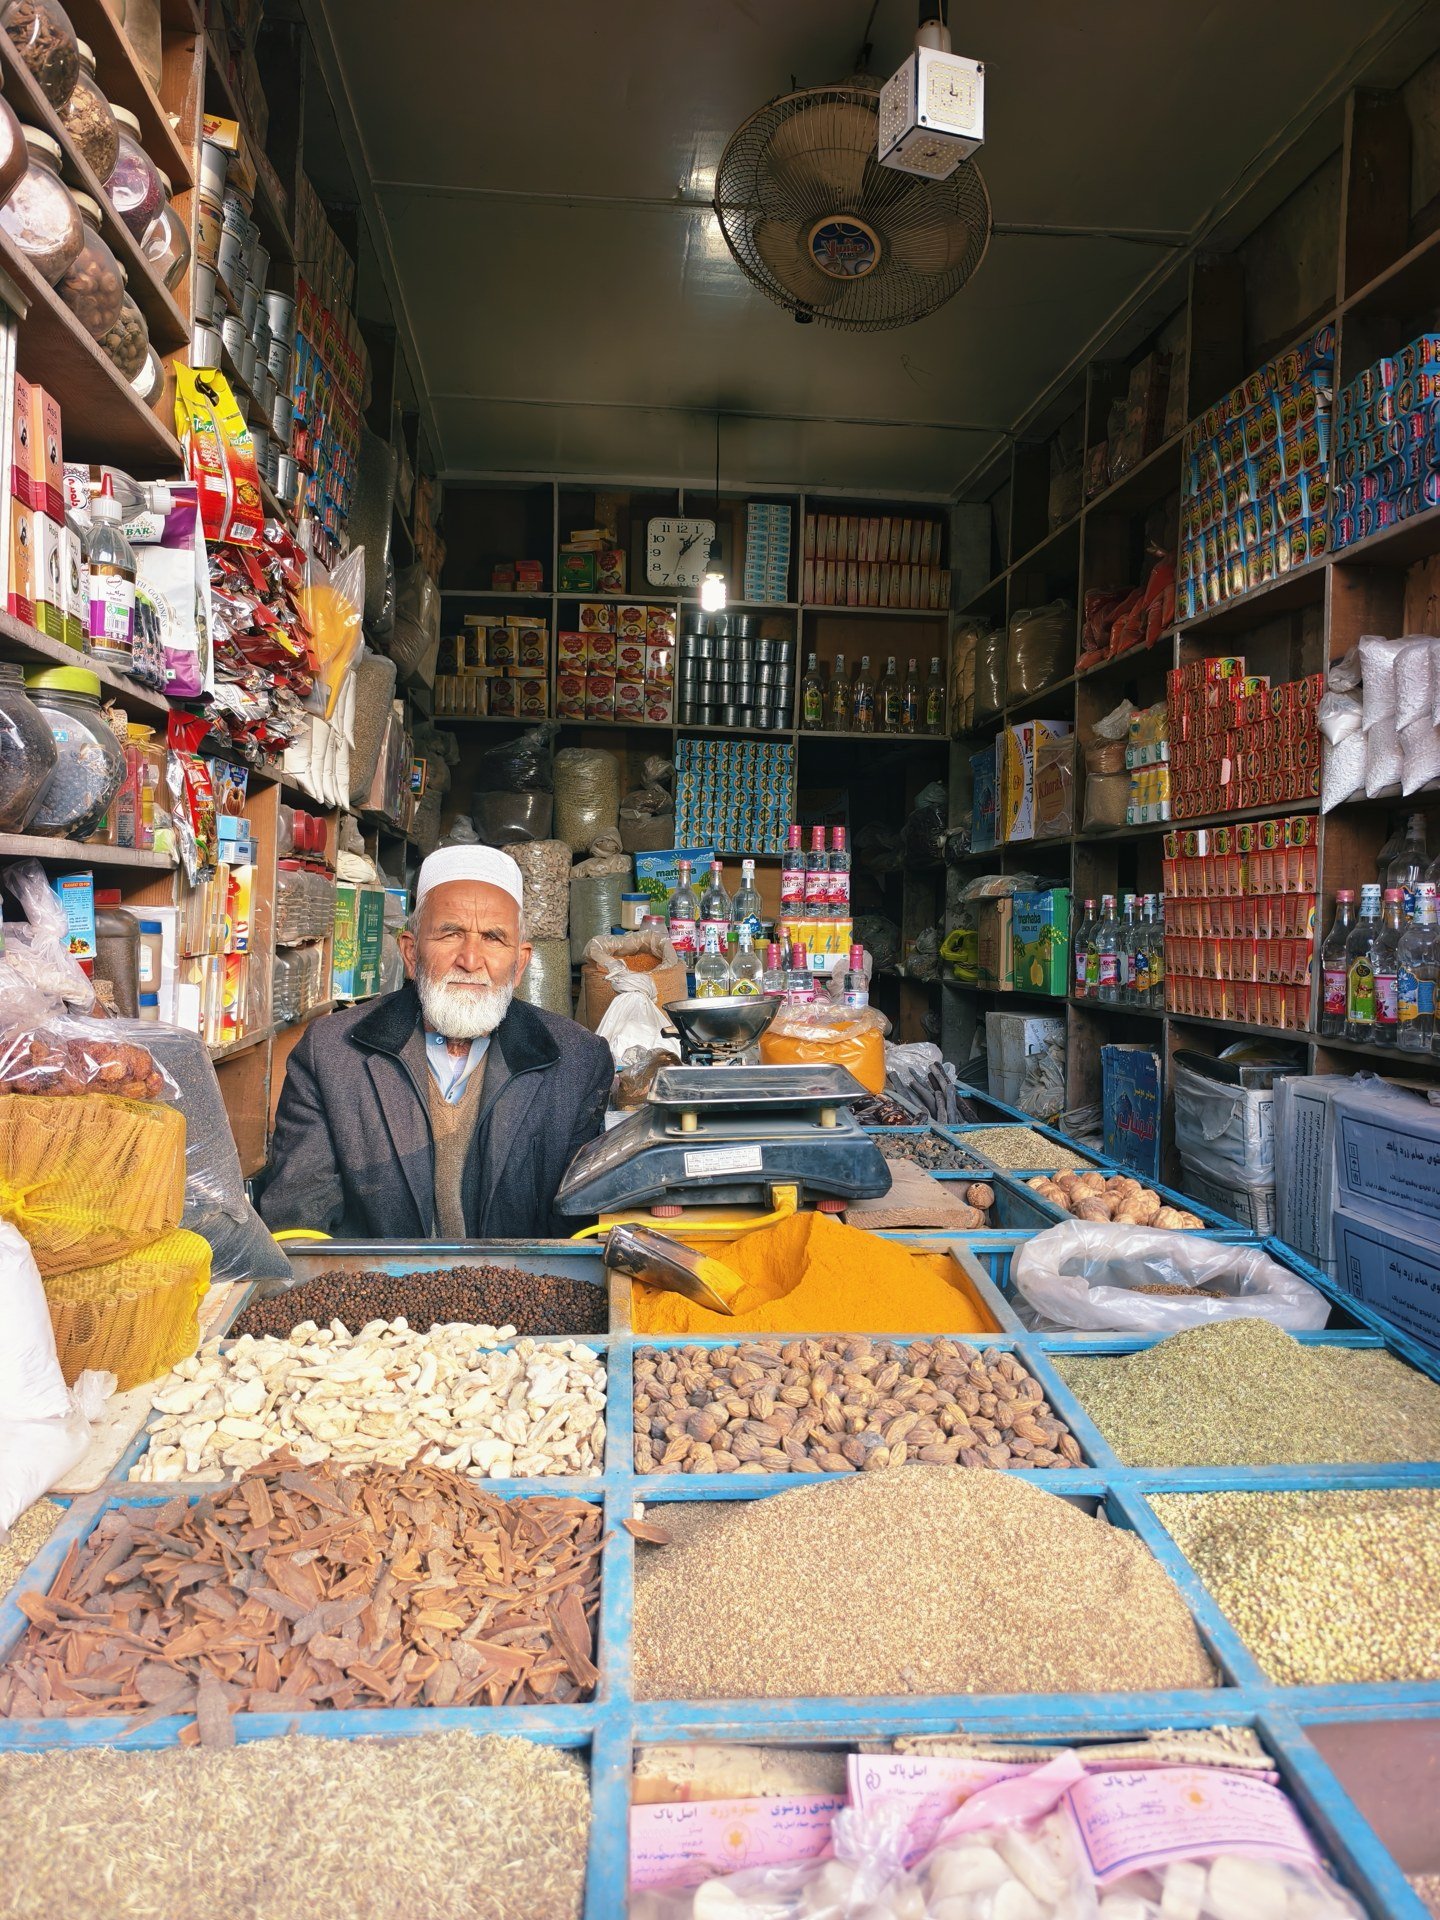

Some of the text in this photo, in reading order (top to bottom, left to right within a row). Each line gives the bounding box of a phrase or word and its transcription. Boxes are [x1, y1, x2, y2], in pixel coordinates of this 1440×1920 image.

[662, 524, 670, 533] 11
[677, 525, 688, 533] 12
[653, 535, 665, 543] 10
[653, 548, 661, 556] 9
[703, 551, 711, 559] 3
[653, 563, 661, 571] 8
[677, 574, 686, 582] 6
[656, 867, 697, 878] marha
